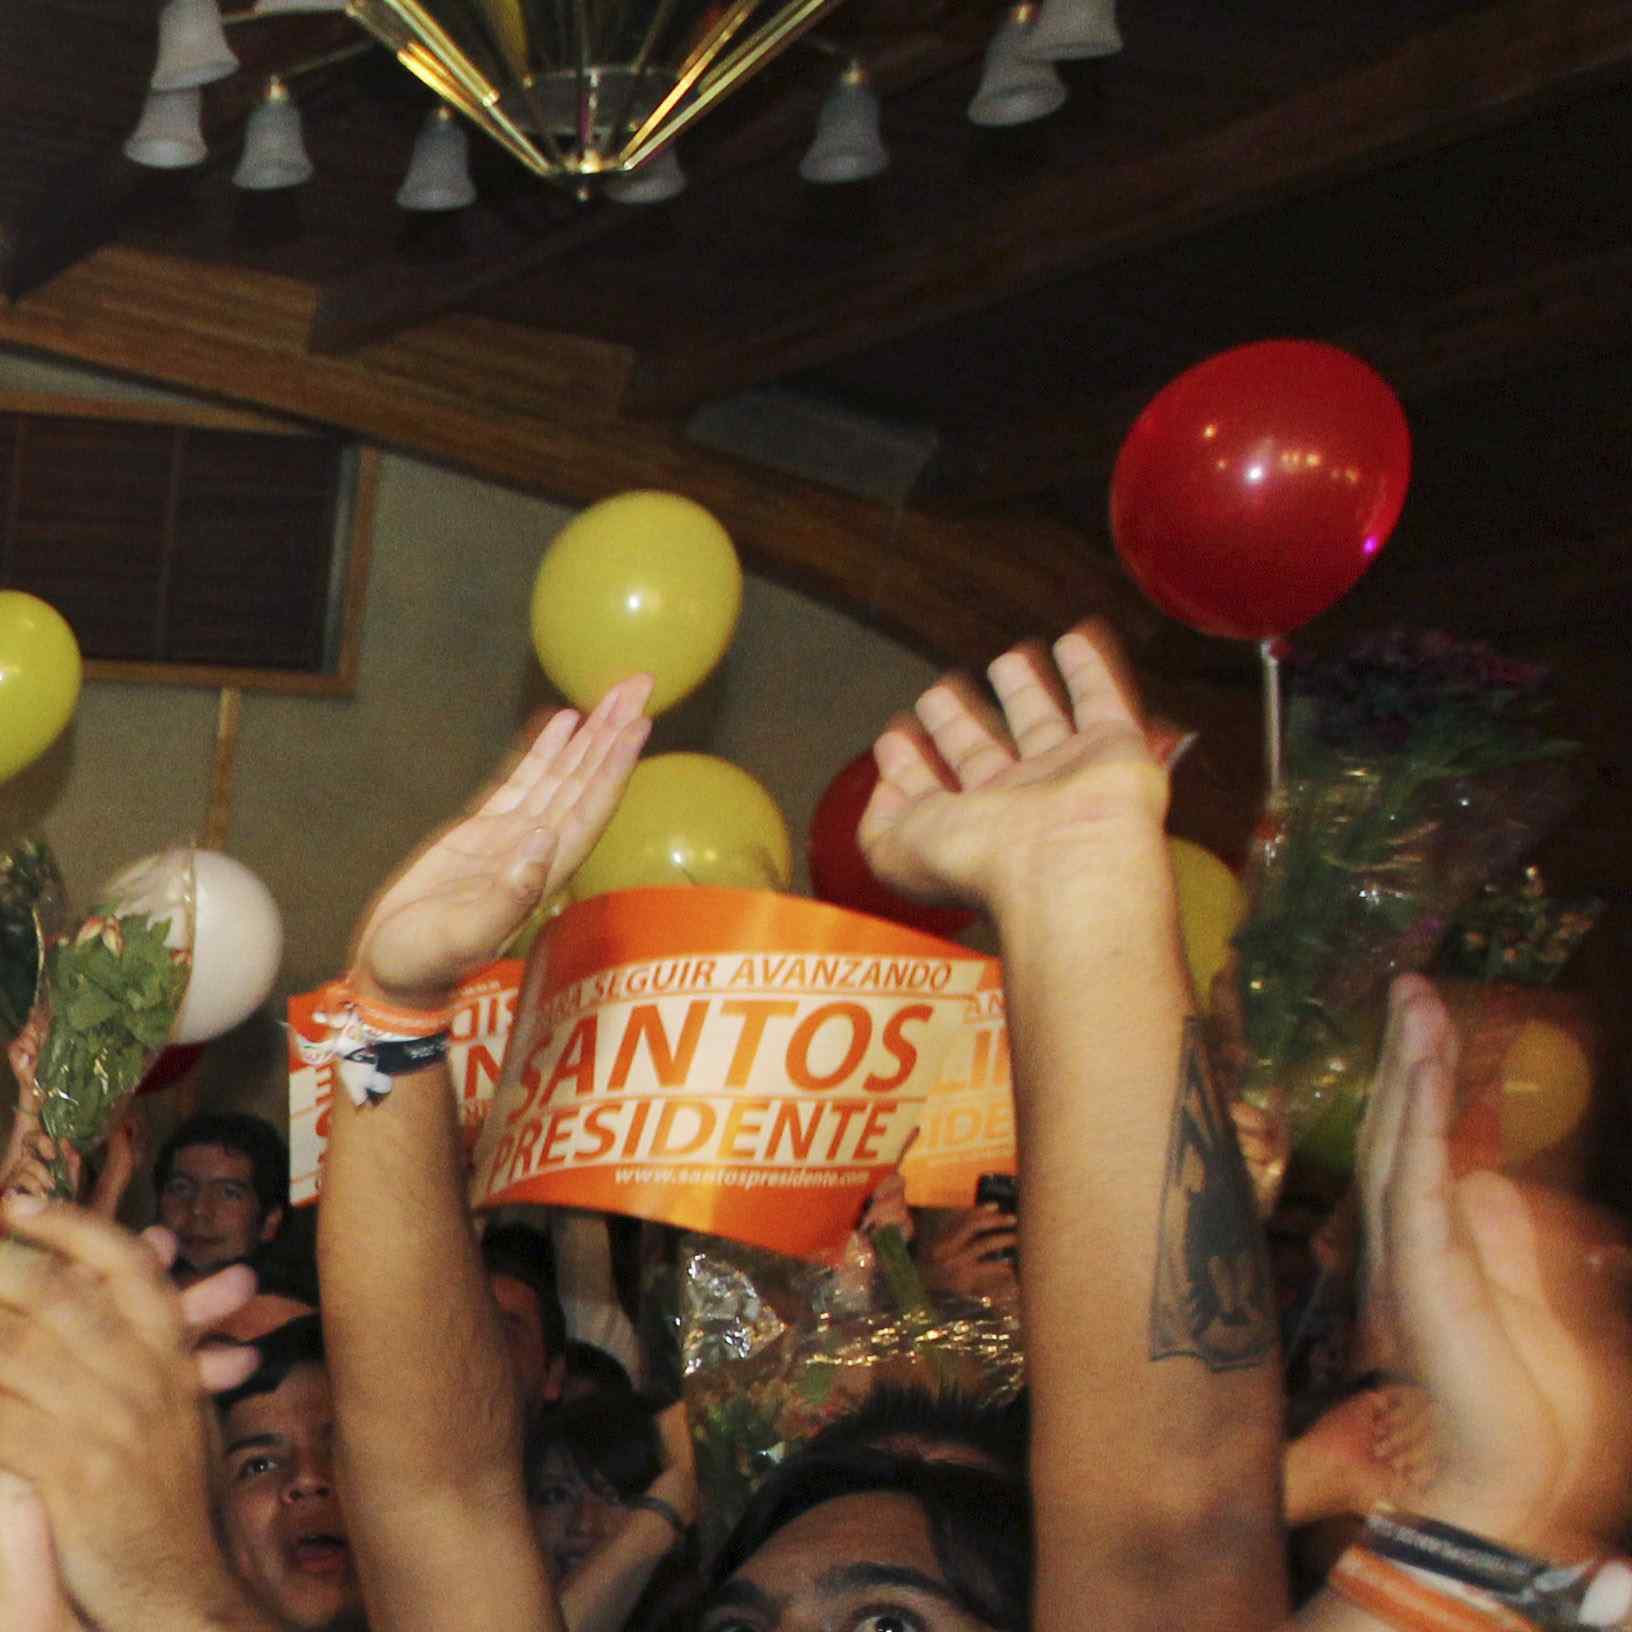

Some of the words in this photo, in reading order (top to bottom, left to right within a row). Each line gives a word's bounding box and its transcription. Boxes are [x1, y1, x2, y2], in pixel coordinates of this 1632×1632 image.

[731, 957, 953, 992] AVANZANDO
[511, 999, 934, 1125] SANTOS
[486, 1100, 898, 1196] PRESIDENTE
